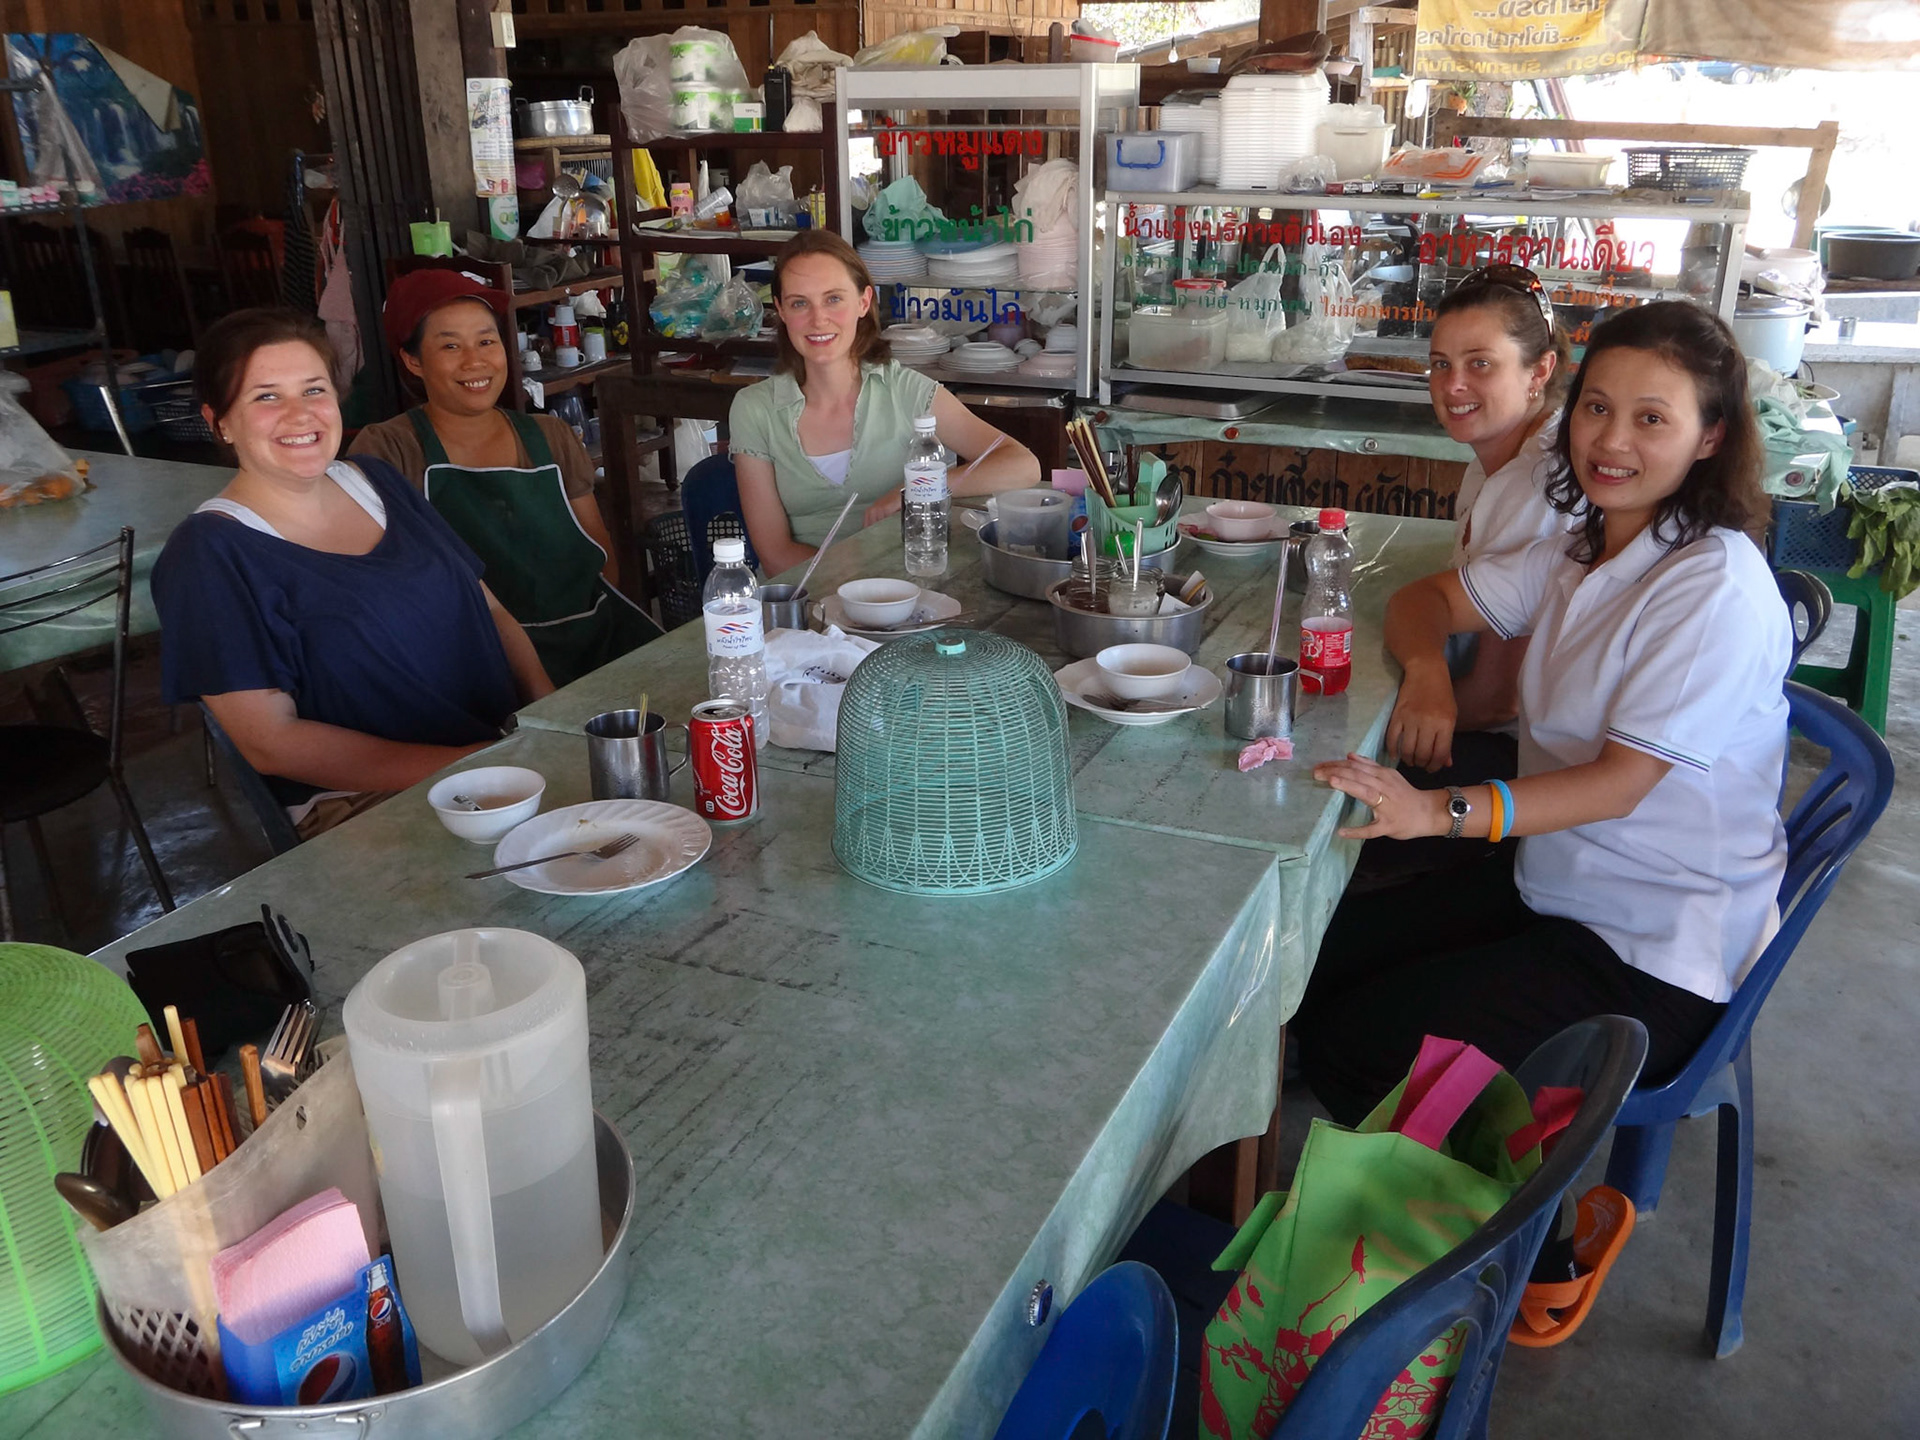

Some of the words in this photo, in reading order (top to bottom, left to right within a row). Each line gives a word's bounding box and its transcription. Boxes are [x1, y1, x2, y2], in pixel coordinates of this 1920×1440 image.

[878, 116, 1044, 171] ข้าวหมูแดง
[881, 204, 1034, 244] ข้าวหน้าไก่
[1123, 201, 1363, 246] น้ำแข็งบริการตัวเอง
[1418, 224, 1656, 273] อาหารจานเดียว
[889, 282, 1022, 327] ข้าวมันไก่
[711, 723, 747, 816] Coca-Cola
